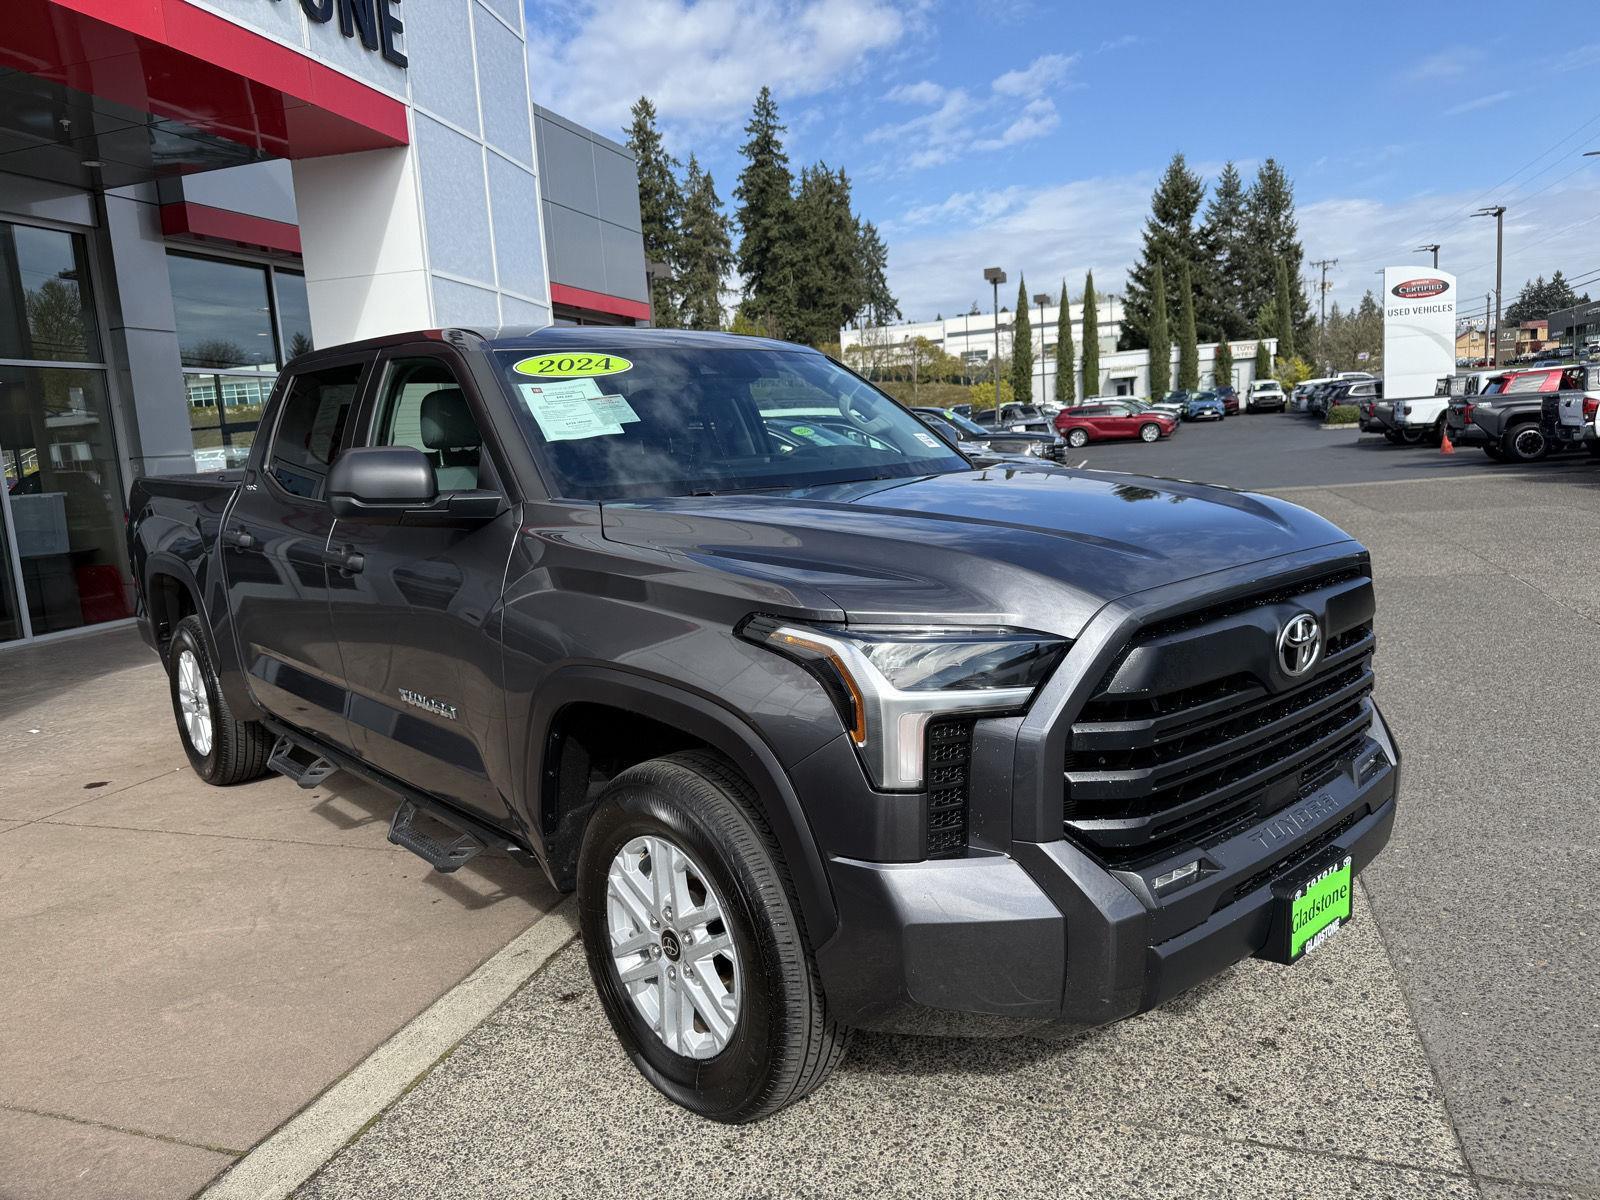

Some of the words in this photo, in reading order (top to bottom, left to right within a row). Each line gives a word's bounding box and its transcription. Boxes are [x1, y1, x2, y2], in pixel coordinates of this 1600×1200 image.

[301, 0, 409, 69] NE
[1398, 284, 1443, 294] CERTIFIED
[1387, 307, 1410, 317] USED
[1412, 304, 1453, 315] VEHICLES
[538, 357, 614, 374] 2024
[1306, 863, 1338, 891] TOYOTA
[1292, 884, 1348, 934] Gladstone
[1305, 917, 1341, 955] GLADSTONE
